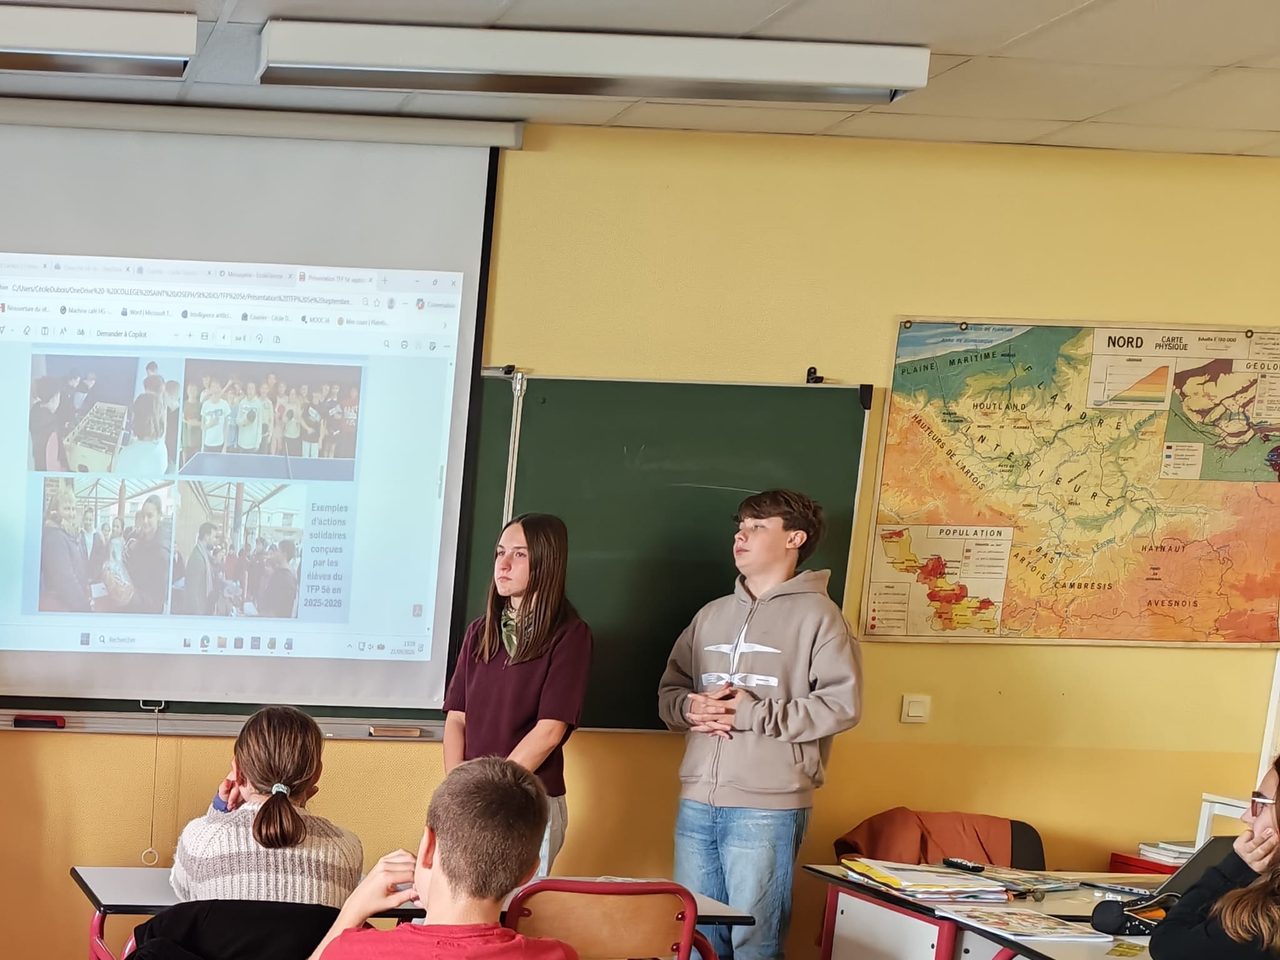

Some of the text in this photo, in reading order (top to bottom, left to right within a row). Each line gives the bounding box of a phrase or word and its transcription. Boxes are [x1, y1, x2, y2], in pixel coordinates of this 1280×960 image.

[96, 330, 123, 338] Demander
[128, 330, 147, 339] Copilot
[1107, 335, 1144, 349] NORD
[1161, 335, 1184, 344] CARTE
[1154, 342, 1188, 351] PHYSIQUE
[901, 363, 936, 375] PLAINE
[949, 351, 998, 366] MARITIME
[1245, 362, 1280, 371] GEOLO
[972, 402, 1026, 411] HOUTLAND
[912, 413, 946, 449] HAUTEURS
[945, 448, 957, 460] DE
[956, 460, 986, 490] L'ARTOIS
[312, 503, 349, 514] Exemples
[312, 517, 347, 526] d'actions
[309, 530, 347, 540] solidaires
[939, 528, 1003, 537] POPULATION
[311, 546, 344, 555] conçues
[1035, 546, 1055, 564] BAS
[313, 558, 339, 568] par les
[1013, 552, 1047, 581] ARTOIS
[332, 572, 343, 581] du
[306, 585, 321, 593] TFP
[304, 598, 342, 608] 2025-2026
